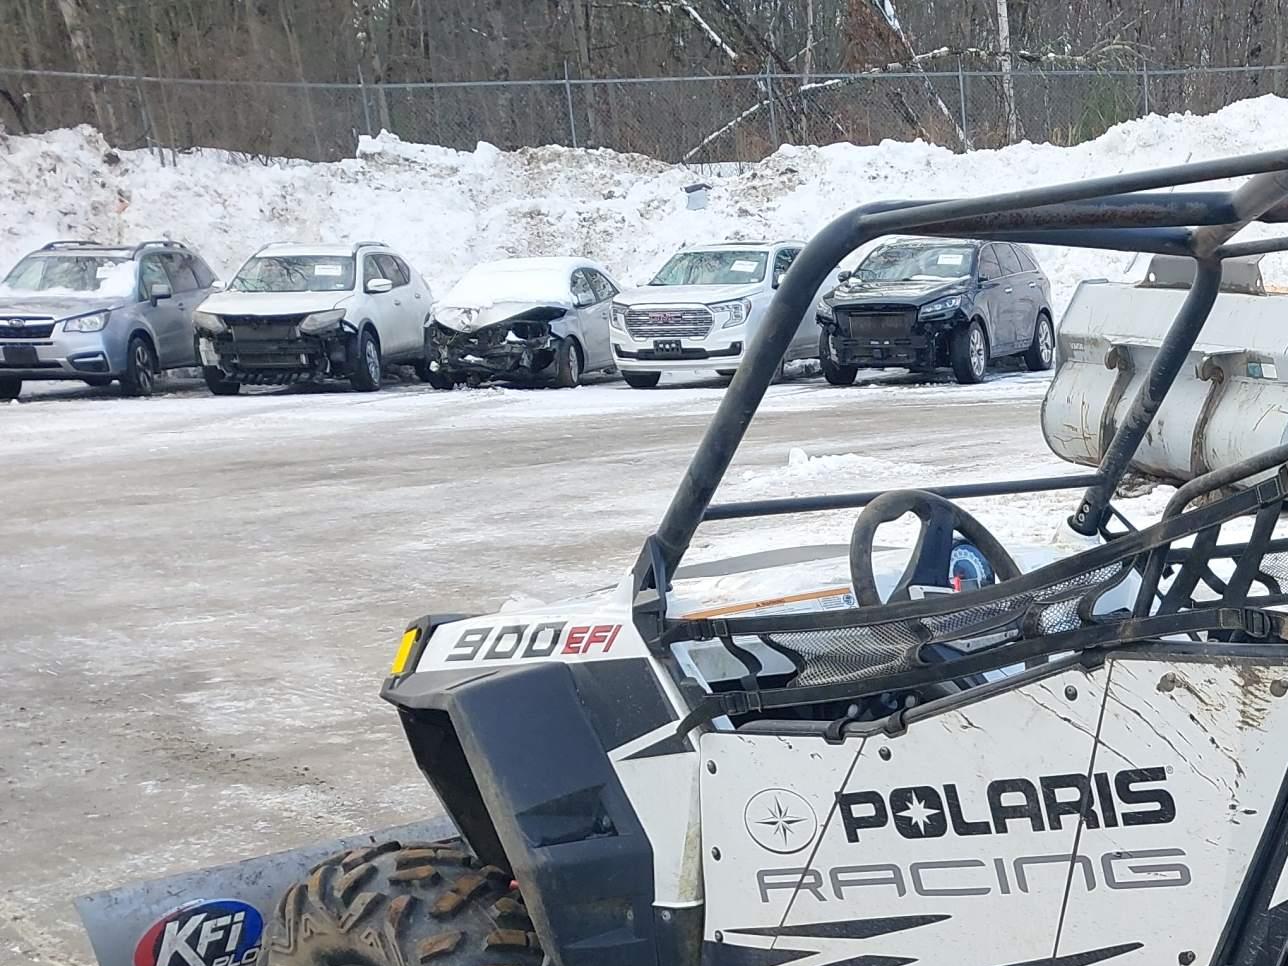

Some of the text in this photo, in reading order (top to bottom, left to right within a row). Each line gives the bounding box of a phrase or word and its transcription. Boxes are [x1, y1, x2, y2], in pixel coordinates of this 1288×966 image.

[445, 620, 622, 662] 900 EFI
[834, 765, 1177, 843] POLARIS
[756, 847, 1192, 903] RACING
